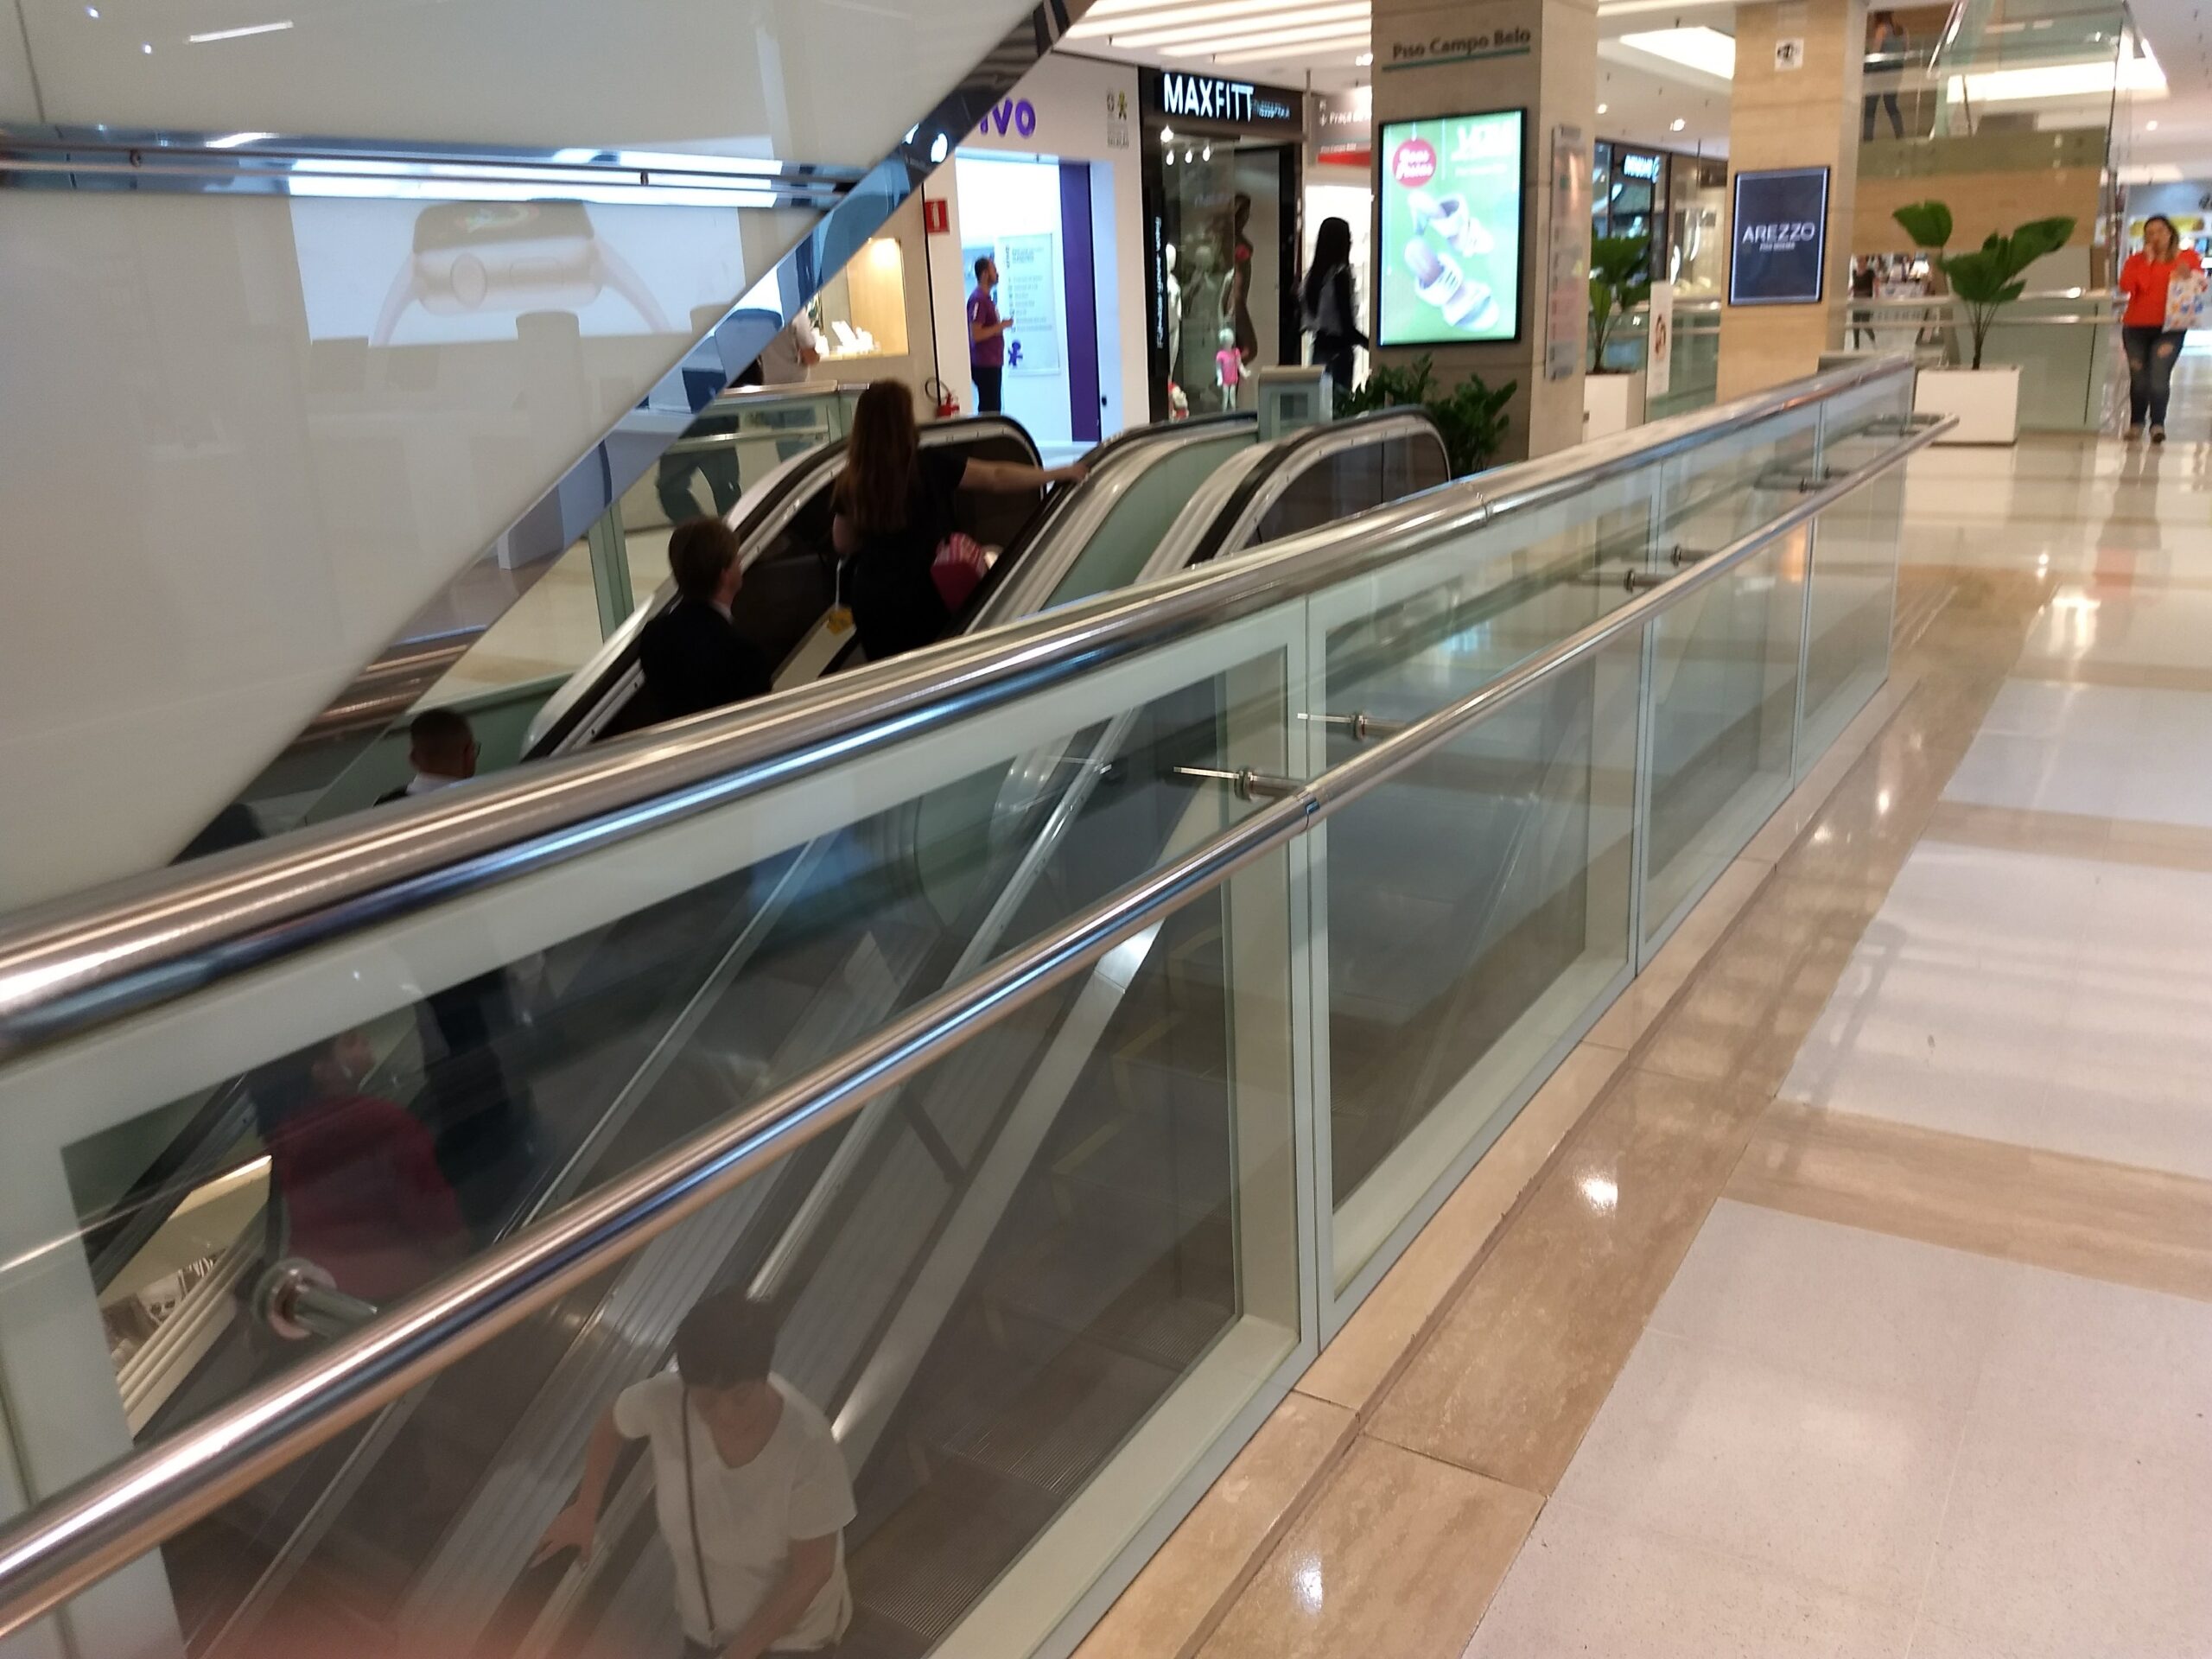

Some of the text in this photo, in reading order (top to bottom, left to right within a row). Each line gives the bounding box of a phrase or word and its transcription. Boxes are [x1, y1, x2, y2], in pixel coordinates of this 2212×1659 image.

[1392, 26, 1531, 60] Piso Campo Belo
[1742, 221, 1815, 244] AREZZO
